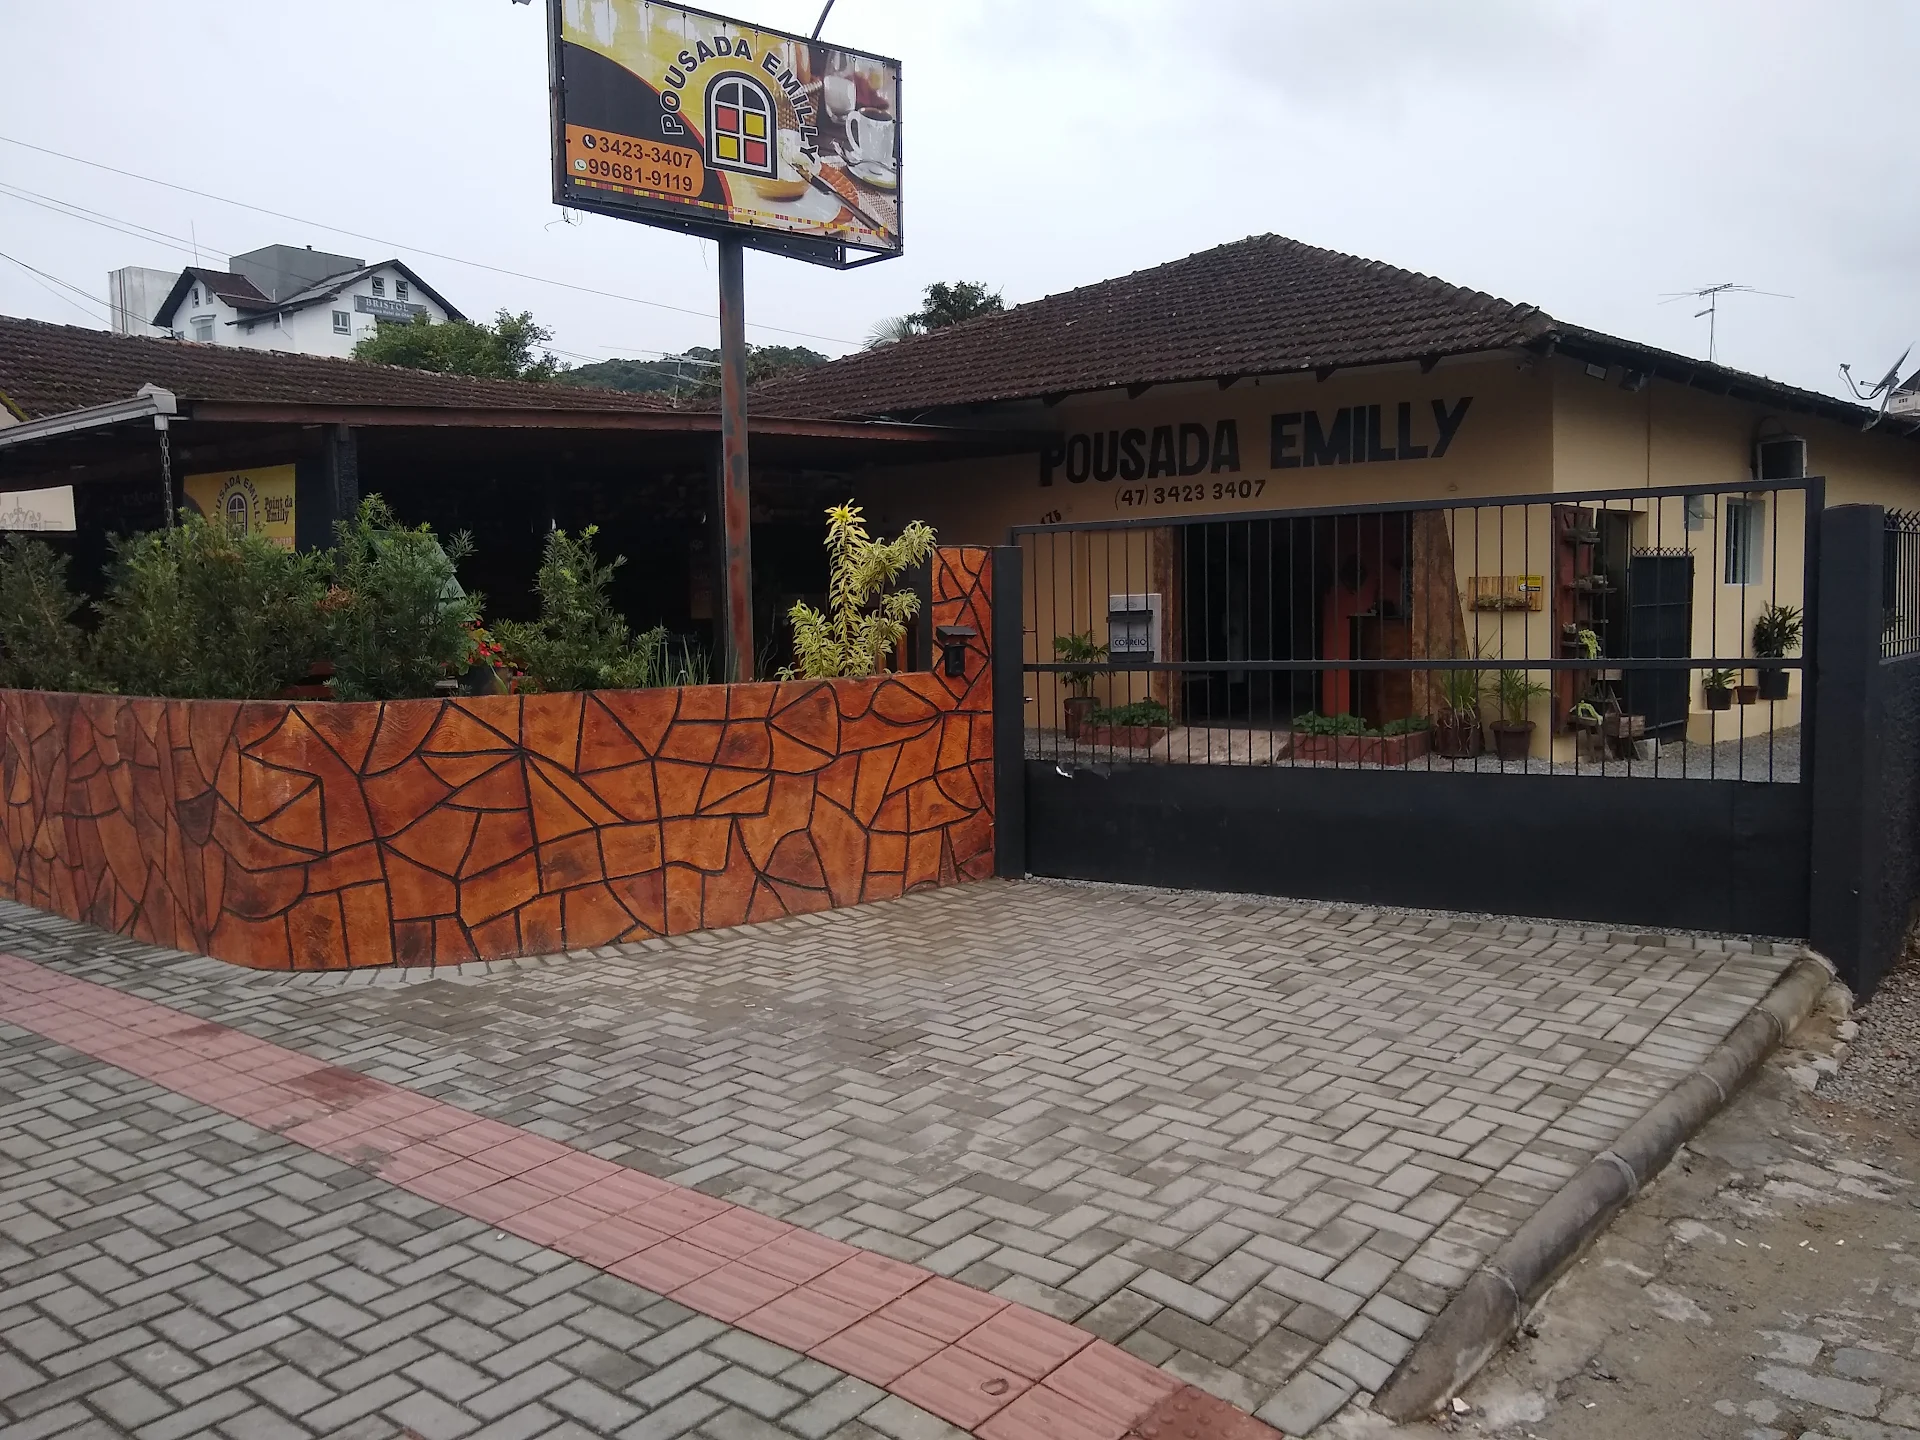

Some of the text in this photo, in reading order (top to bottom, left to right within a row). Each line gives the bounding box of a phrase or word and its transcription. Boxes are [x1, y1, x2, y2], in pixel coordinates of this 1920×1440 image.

[660, 36, 819, 165] POUSADA EMILLY
[599, 136, 693, 169] 3423-3407
[588, 158, 693, 192] 99681-9119
[366, 298, 409, 312] BRISTOL
[1039, 397, 1474, 487] POUSADA EMILLY
[264, 494, 293, 511] Point da
[1115, 480, 1266, 510] (47) 3423 3407
[266, 508, 290, 524] Emilly
